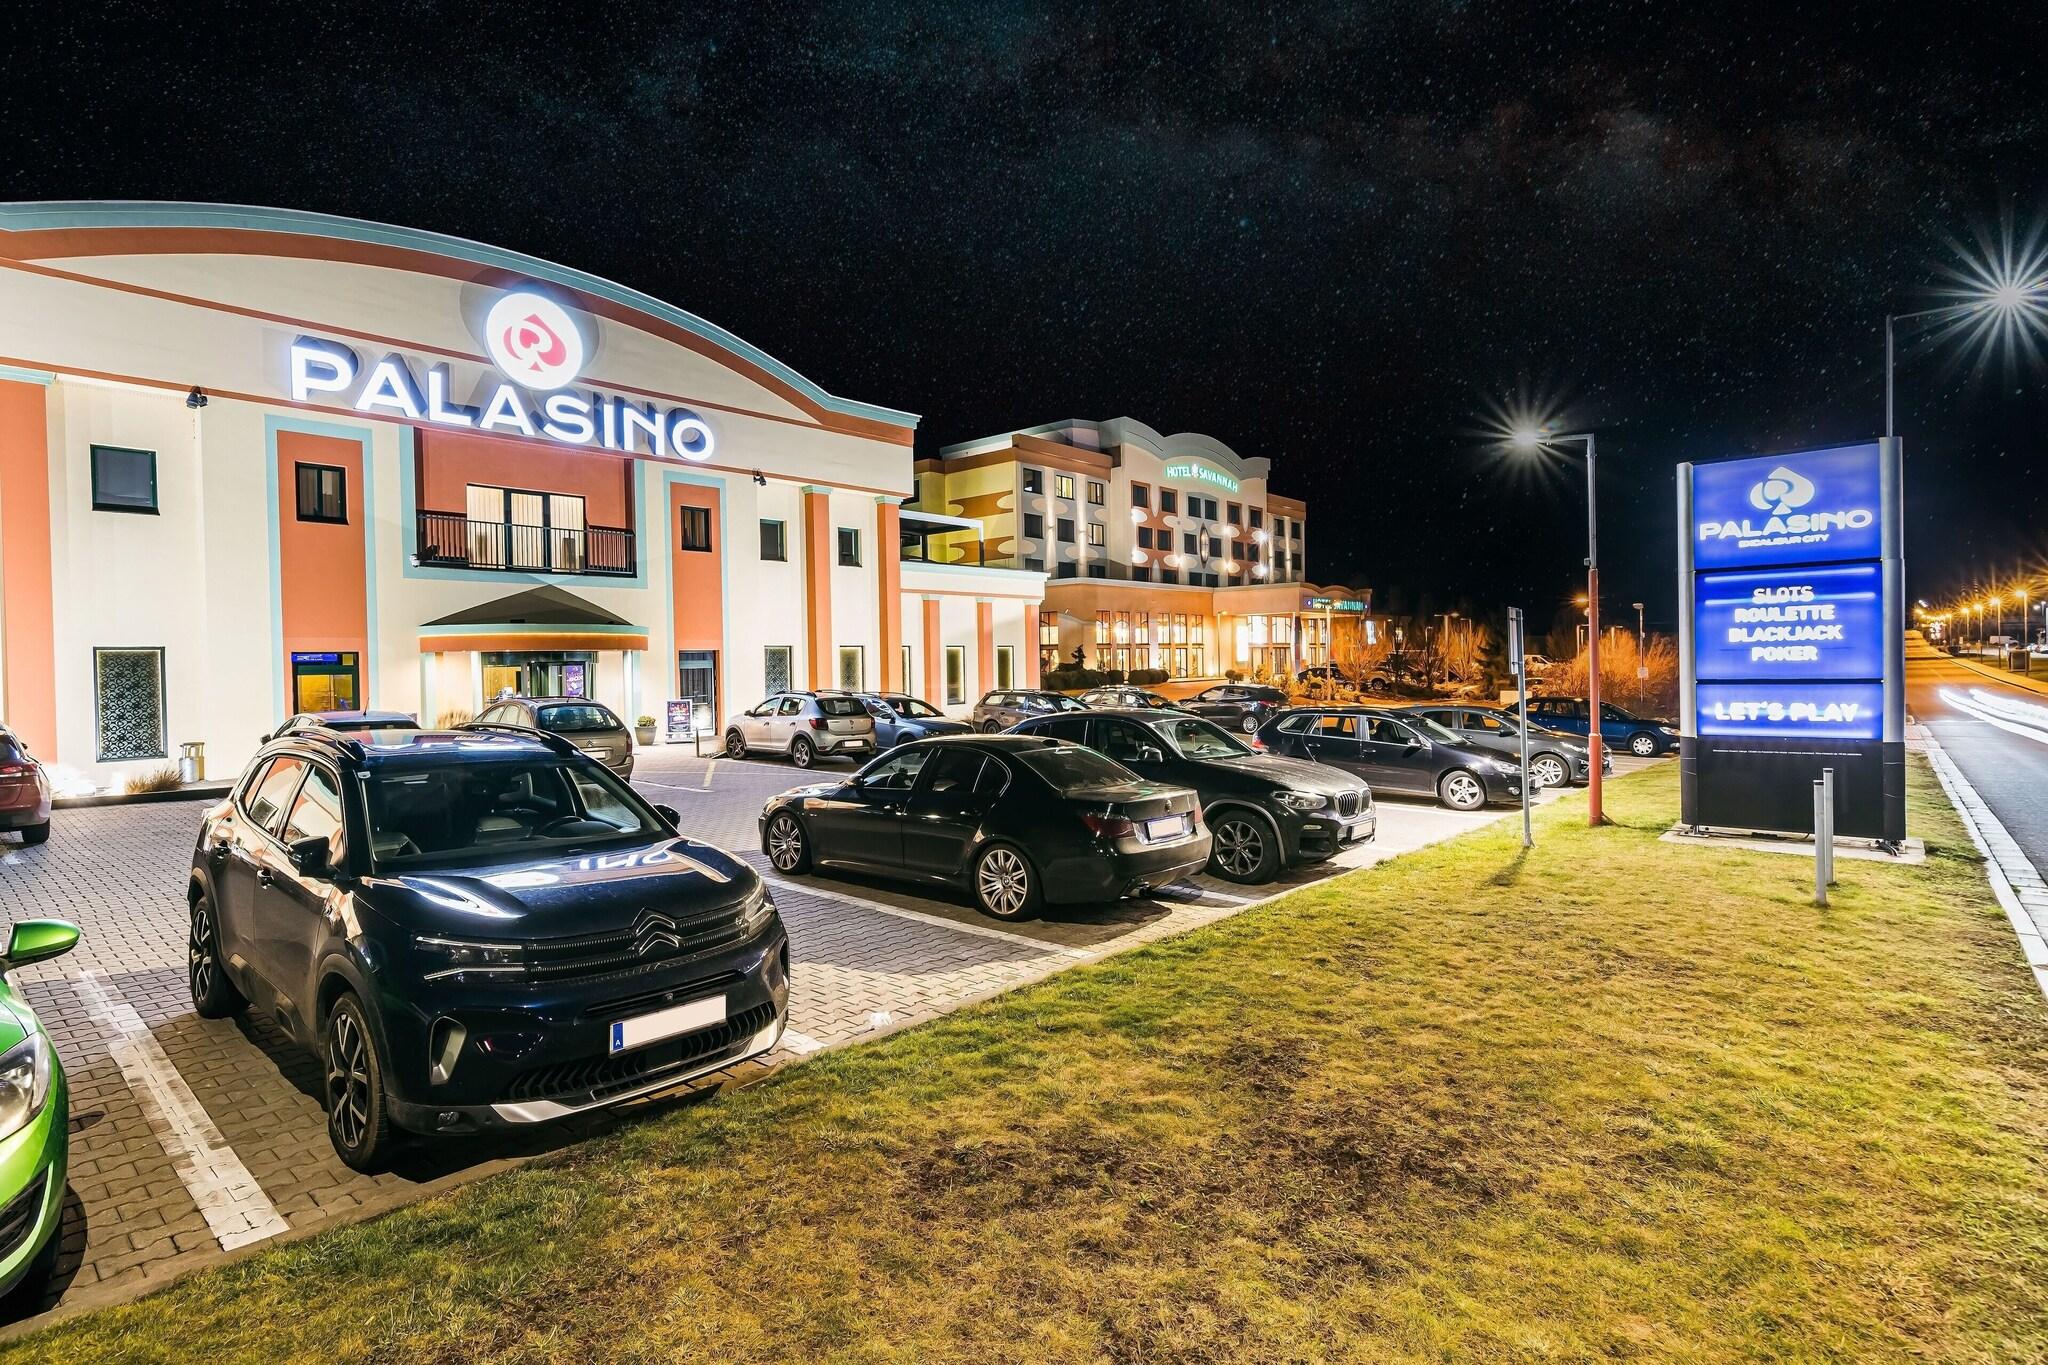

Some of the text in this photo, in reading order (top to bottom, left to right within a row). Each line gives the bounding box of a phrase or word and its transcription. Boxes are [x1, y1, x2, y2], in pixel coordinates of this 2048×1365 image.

[290, 343, 716, 462] PALASINO
[1166, 465, 1238, 493] HOTEL SAVANNAH
[1699, 508, 1873, 541] PALASINO
[1752, 585, 1815, 604] SLOTS
[1734, 604, 1836, 623] ROULETTE
[1728, 624, 1843, 642] BLACKJACK
[1751, 645, 1818, 661] POKER
[1714, 701, 1859, 722] LET'S PLAY
